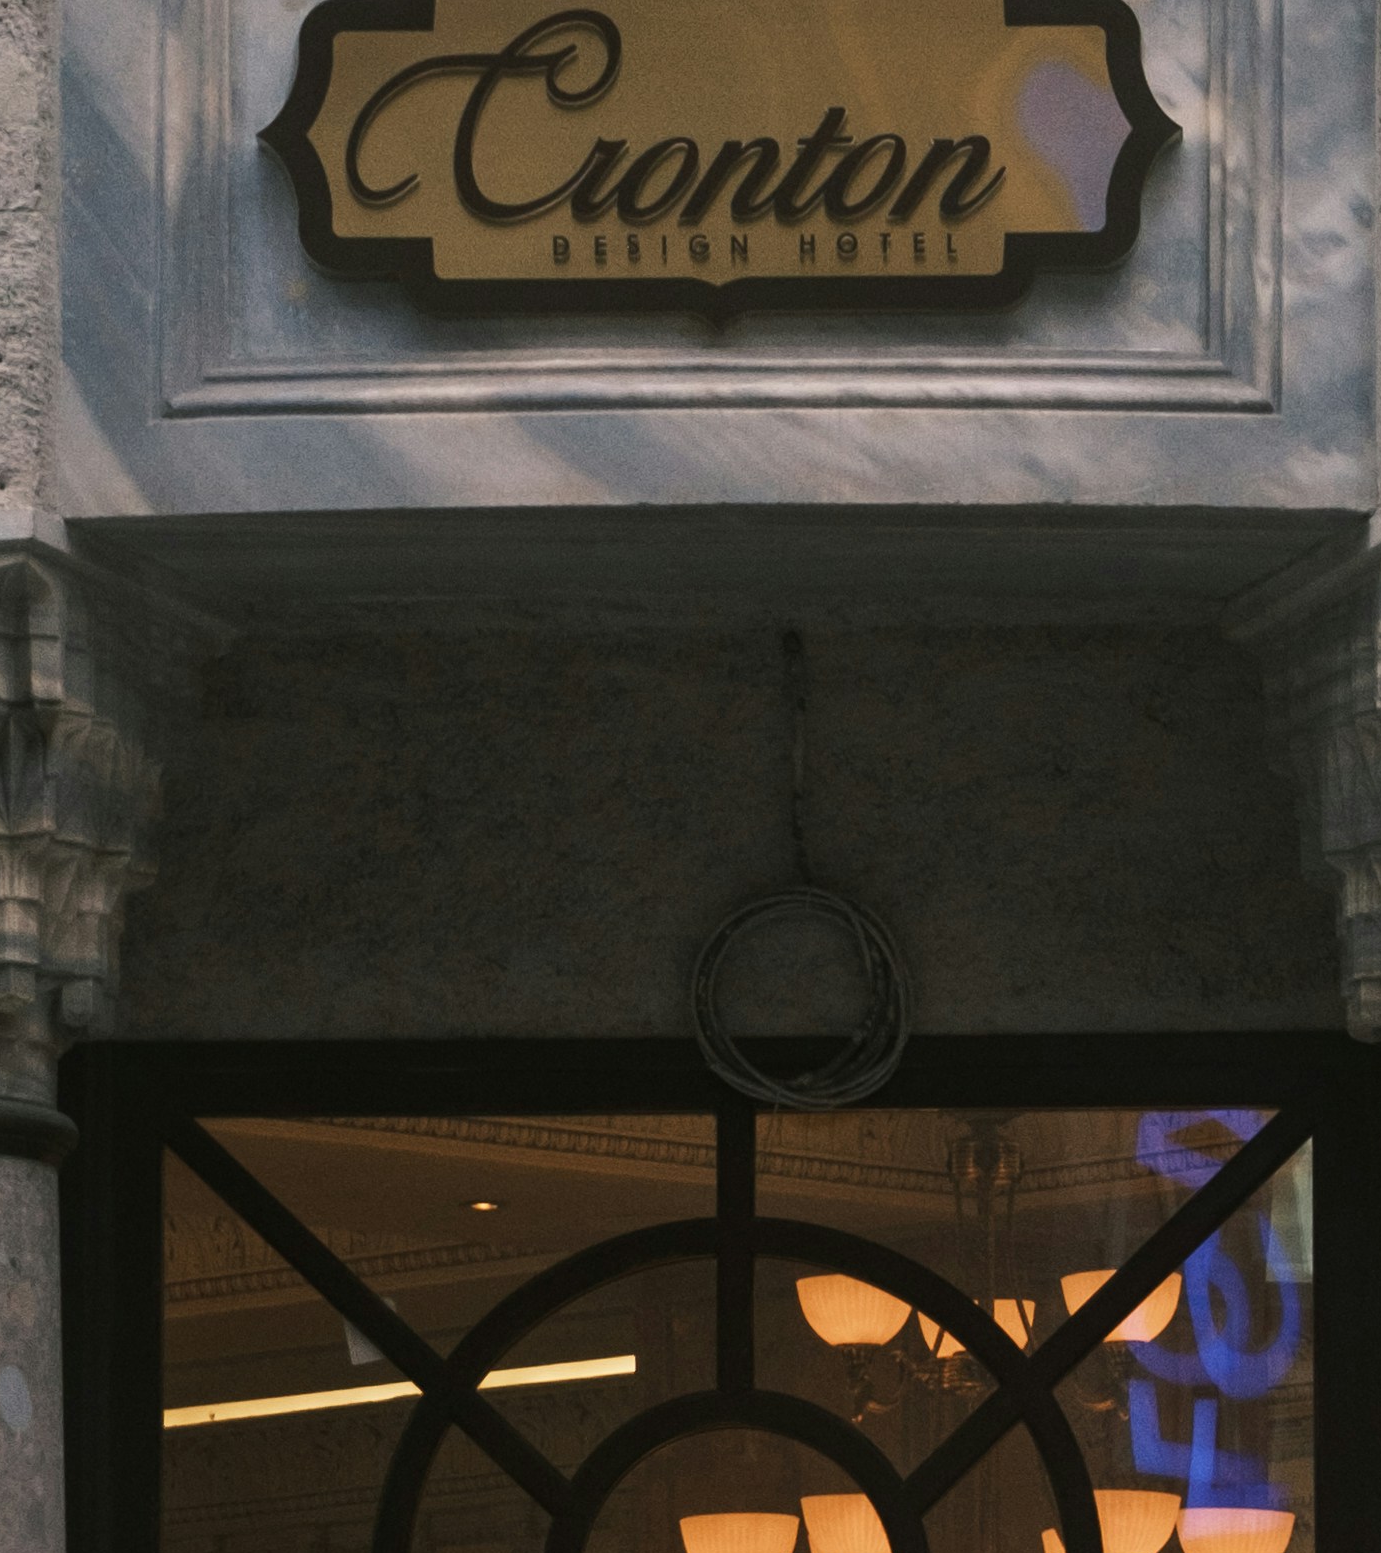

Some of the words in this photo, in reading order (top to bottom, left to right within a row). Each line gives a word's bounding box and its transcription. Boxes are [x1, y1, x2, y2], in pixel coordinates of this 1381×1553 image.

[344, 8, 1007, 226] Cronton
[551, 233, 750, 260] DESIGN
[799, 231, 958, 258] HOTEL
